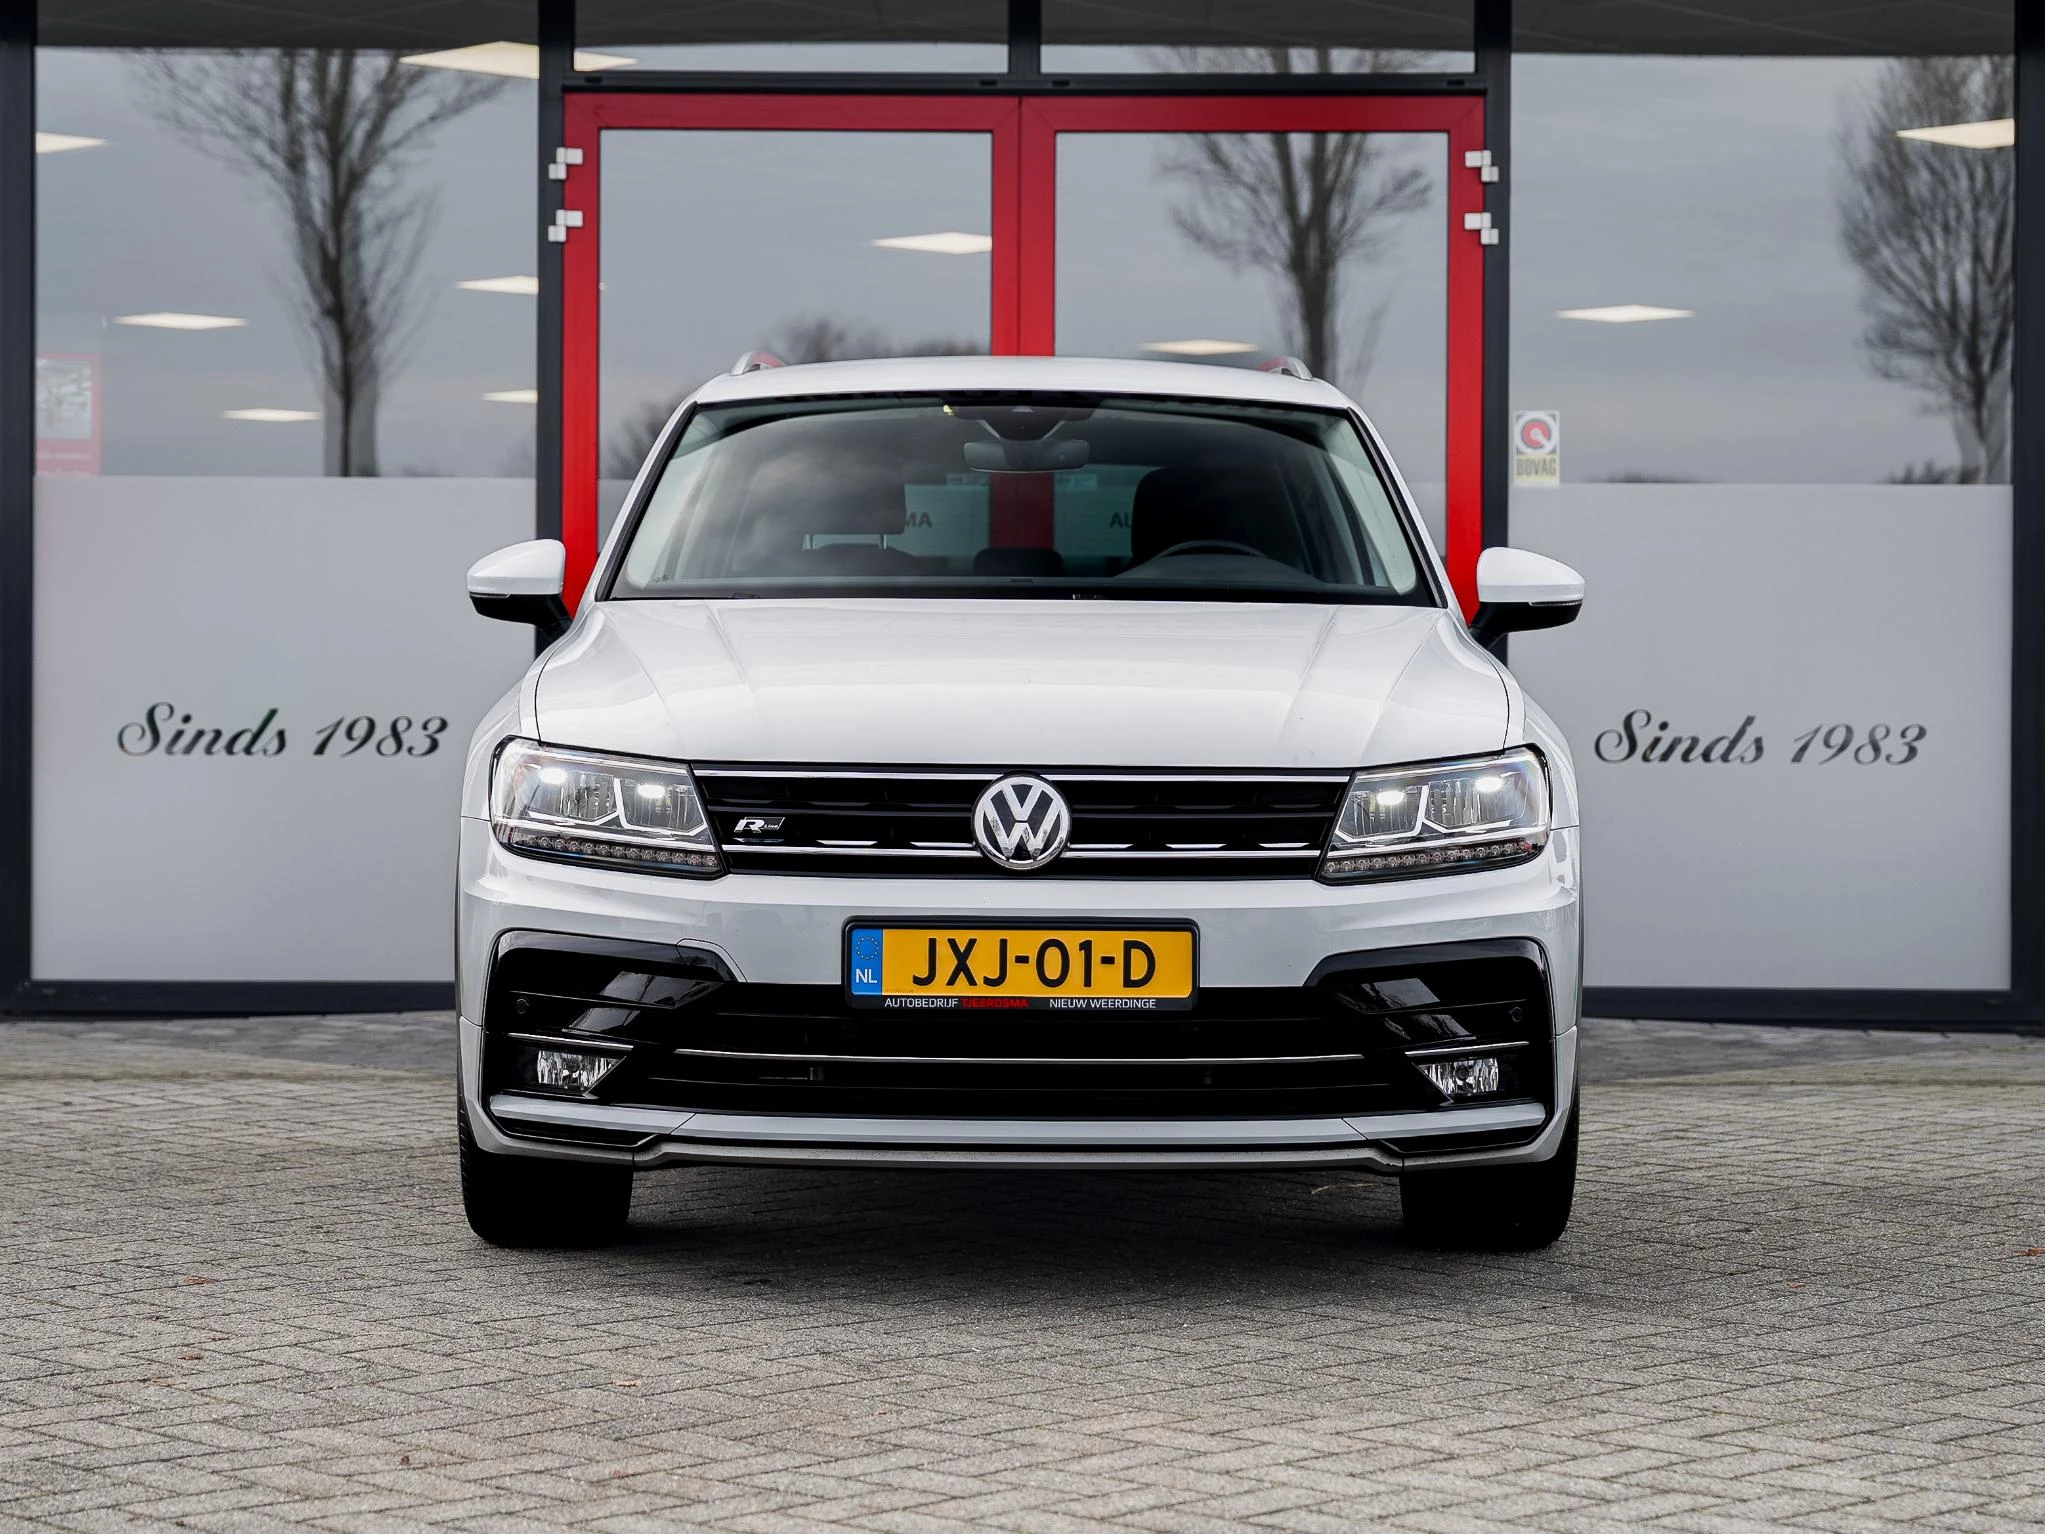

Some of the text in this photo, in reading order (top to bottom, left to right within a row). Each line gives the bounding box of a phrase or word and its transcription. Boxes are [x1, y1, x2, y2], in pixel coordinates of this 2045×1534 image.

[1516, 458, 1557, 476] BOVAG
[117, 701, 449, 758] Sinds 1983
[1594, 709, 1928, 766] Sinds 1983
[855, 968, 878, 984] NL
[912, 937, 1157, 989] JXJ-01-D
[884, 997, 1157, 1009] AUTOBEDRIJF TJEERDSMA NIEUW WEERDINGE
